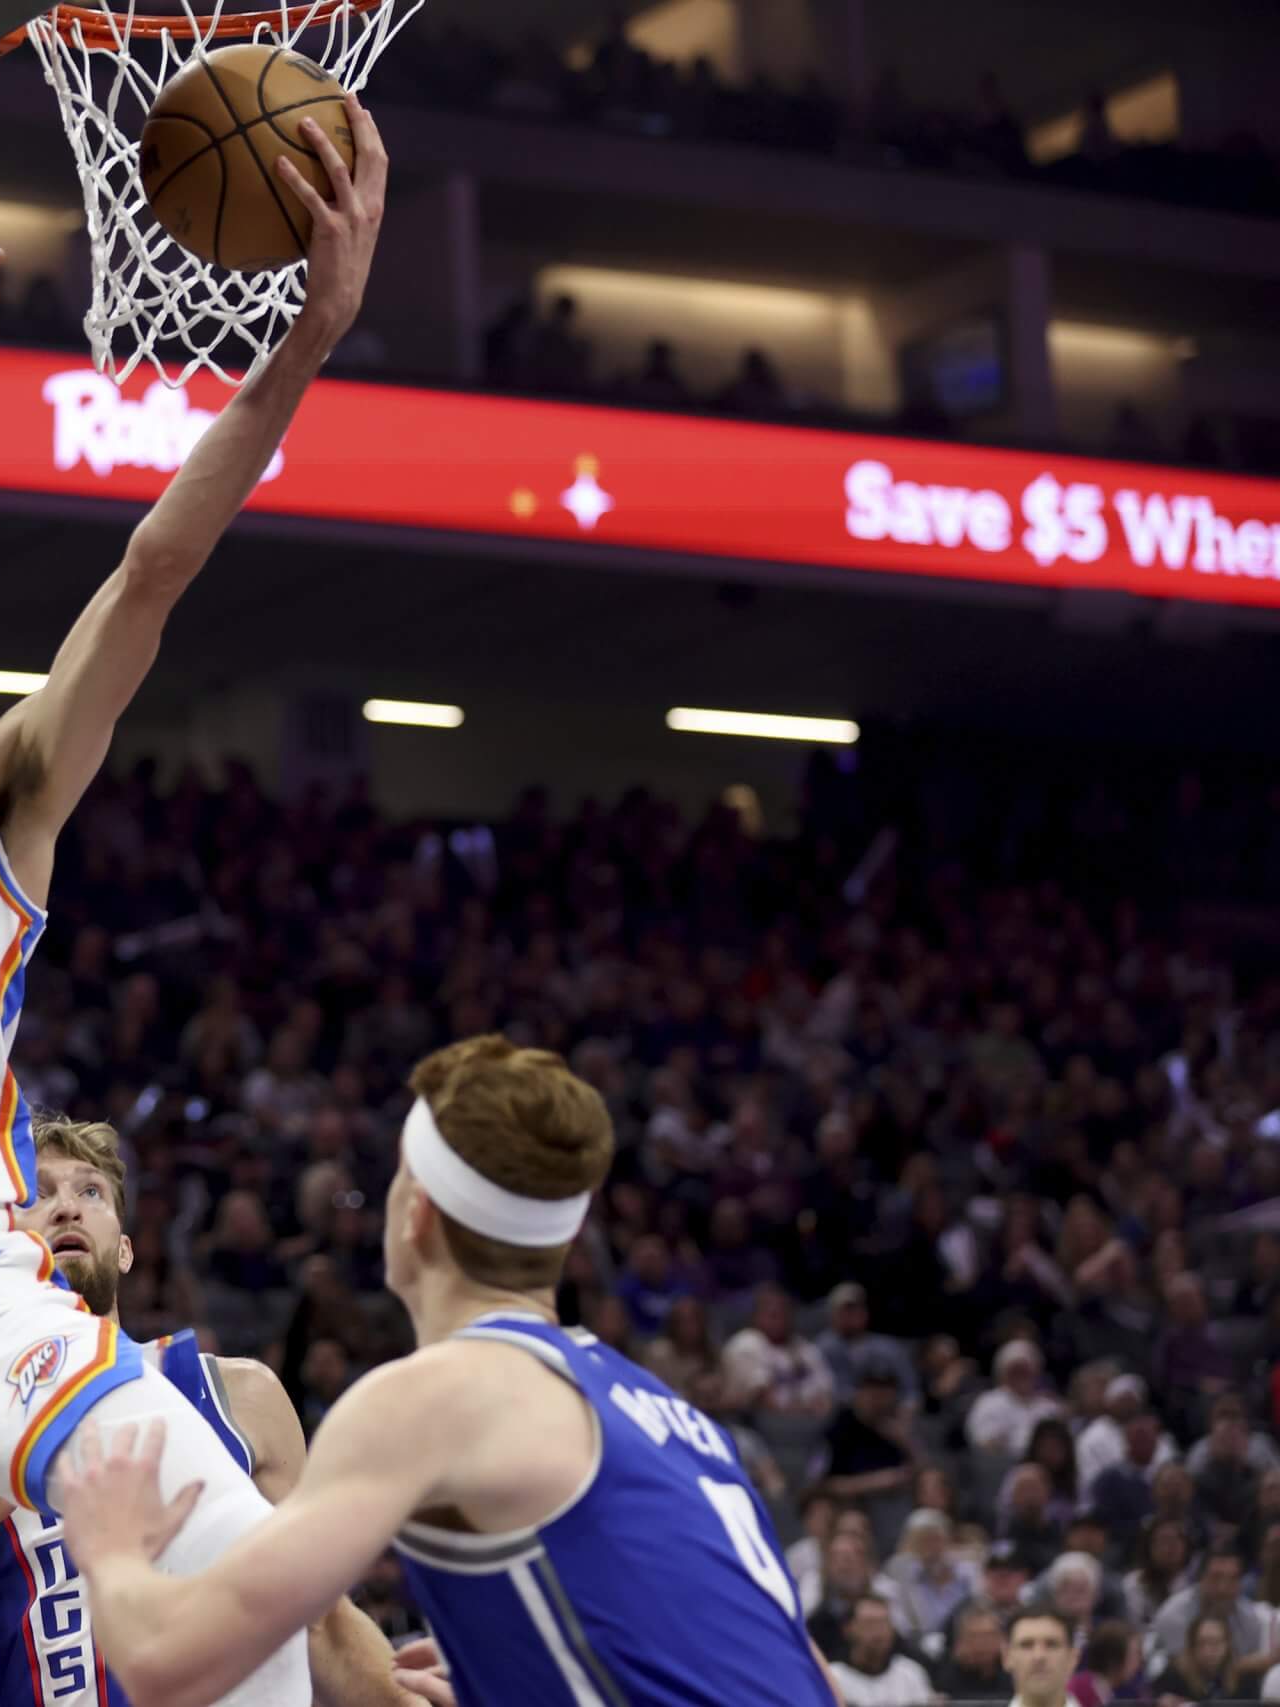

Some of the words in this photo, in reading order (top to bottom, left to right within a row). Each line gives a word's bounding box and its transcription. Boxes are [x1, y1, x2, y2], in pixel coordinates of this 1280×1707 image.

[844, 460, 1012, 552] Save
[1022, 472, 1108, 566] $5
[1113, 489, 1280, 580] Whe
[35, 1512, 87, 1698] NGS
